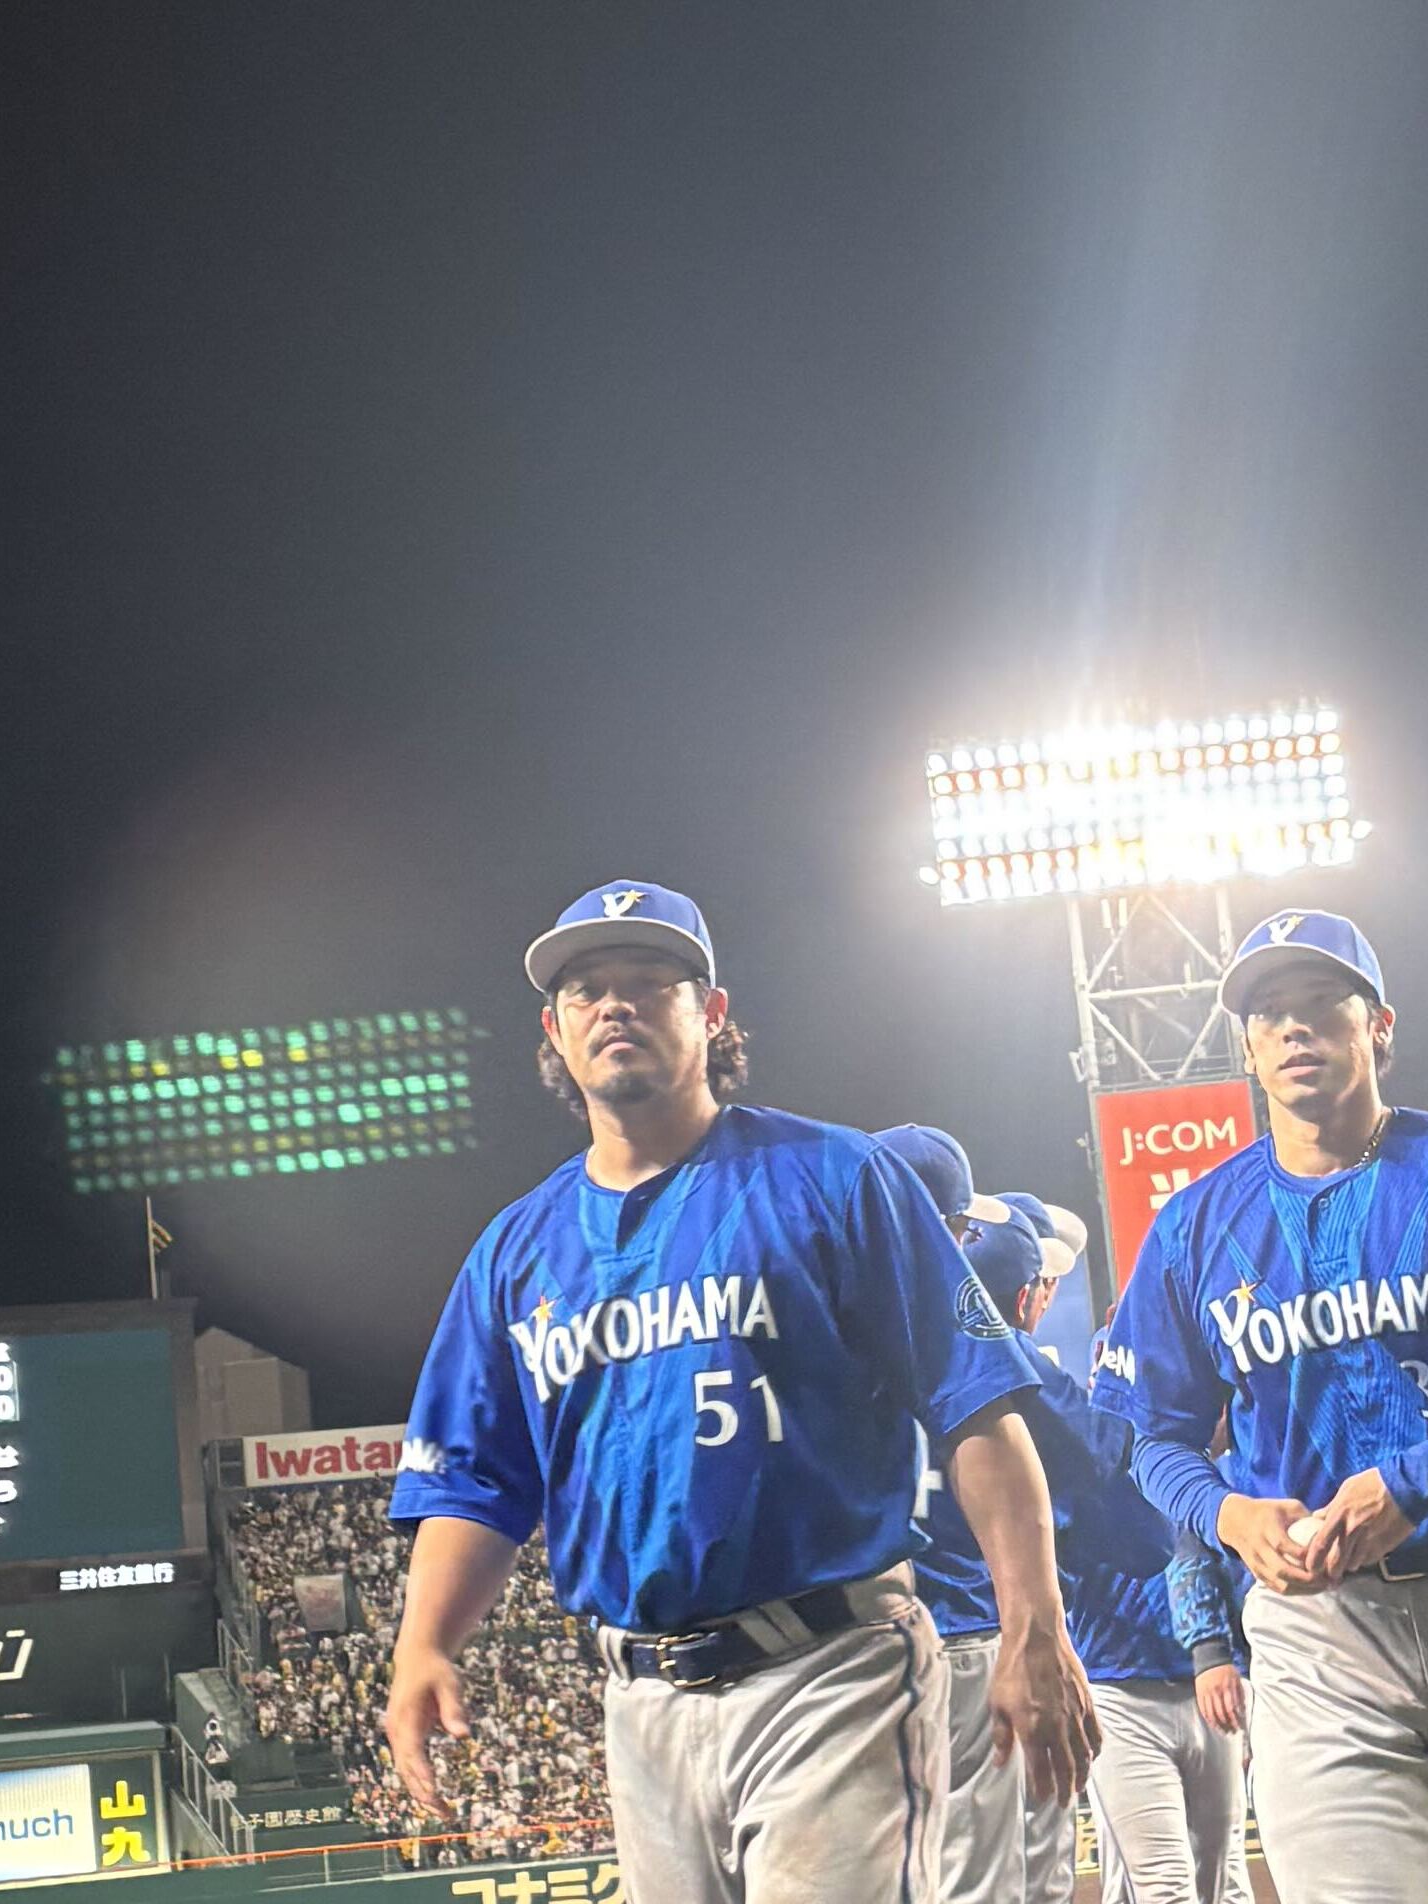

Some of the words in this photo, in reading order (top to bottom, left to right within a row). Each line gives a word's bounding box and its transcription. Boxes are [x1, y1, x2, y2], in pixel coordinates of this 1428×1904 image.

[1120, 1116, 1237, 1166] J:COM
[508, 1275, 780, 1404] YOKOHAMA
[694, 1369, 784, 1447] 51
[100, 1780, 151, 1866] 山九
